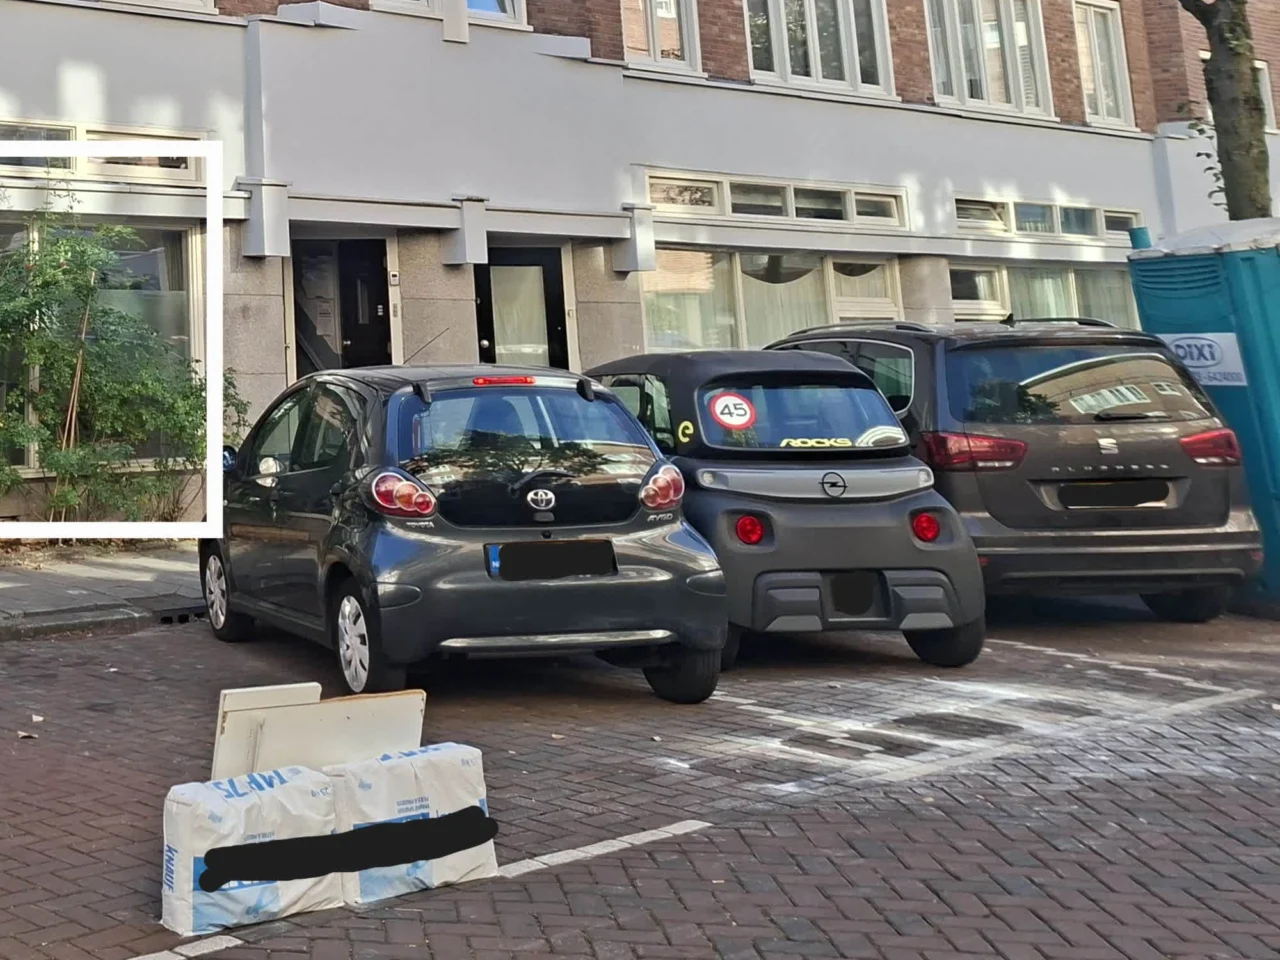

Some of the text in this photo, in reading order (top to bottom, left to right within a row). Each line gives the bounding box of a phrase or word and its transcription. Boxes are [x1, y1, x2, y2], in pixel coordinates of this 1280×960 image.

[720, 402, 748, 418] 45
[779, 437, 853, 448] ROCKS
[646, 512, 674, 523] AYGO
[405, 520, 436, 529] TOYOTA
[163, 843, 179, 894] KNAUF
